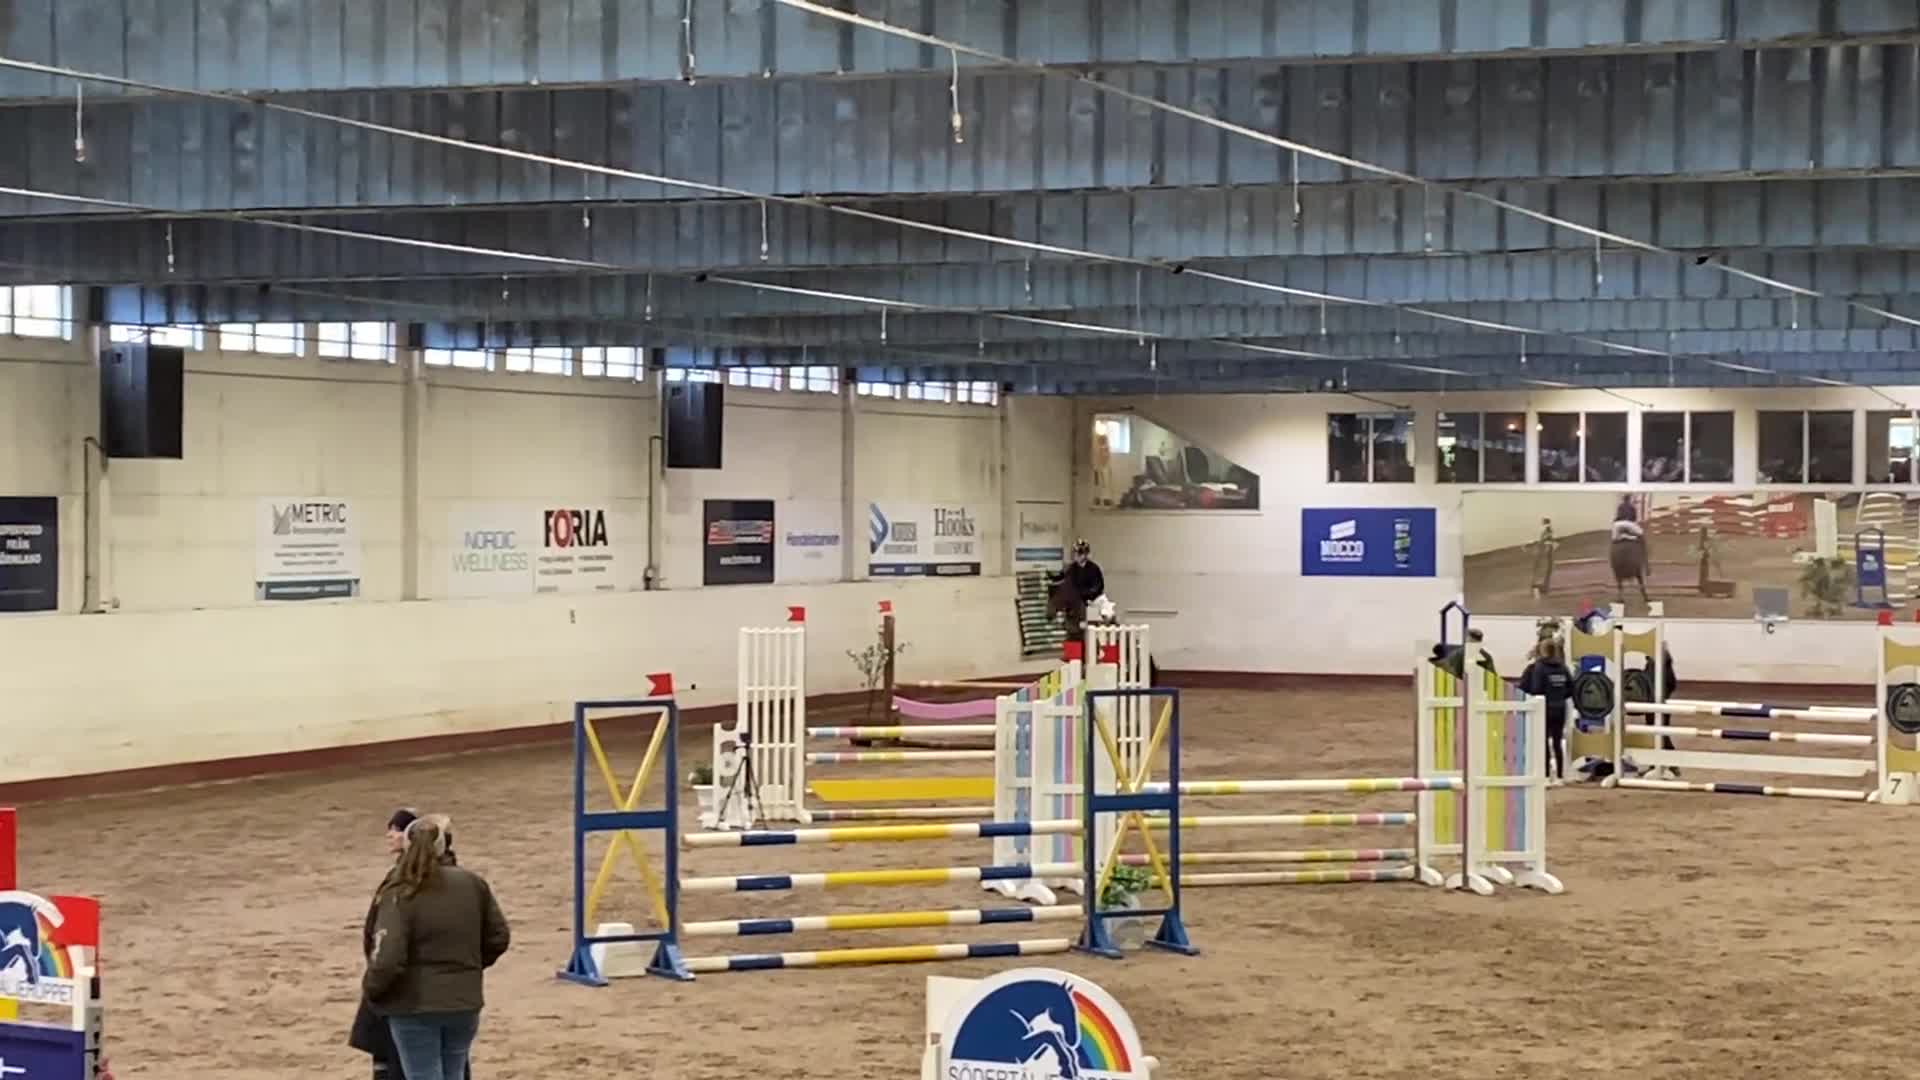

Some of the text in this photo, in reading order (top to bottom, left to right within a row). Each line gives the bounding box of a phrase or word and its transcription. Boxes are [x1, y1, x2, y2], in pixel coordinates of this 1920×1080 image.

[291, 503, 347, 523] METRIC
[544, 508, 609, 548] FORIA
[464, 530, 517, 550] NORDIC
[1320, 539, 1364, 556] NOCCO
[452, 552, 529, 573] WELLNESS
[1766, 621, 1776, 634] C
[1890, 778, 1902, 795] 7
